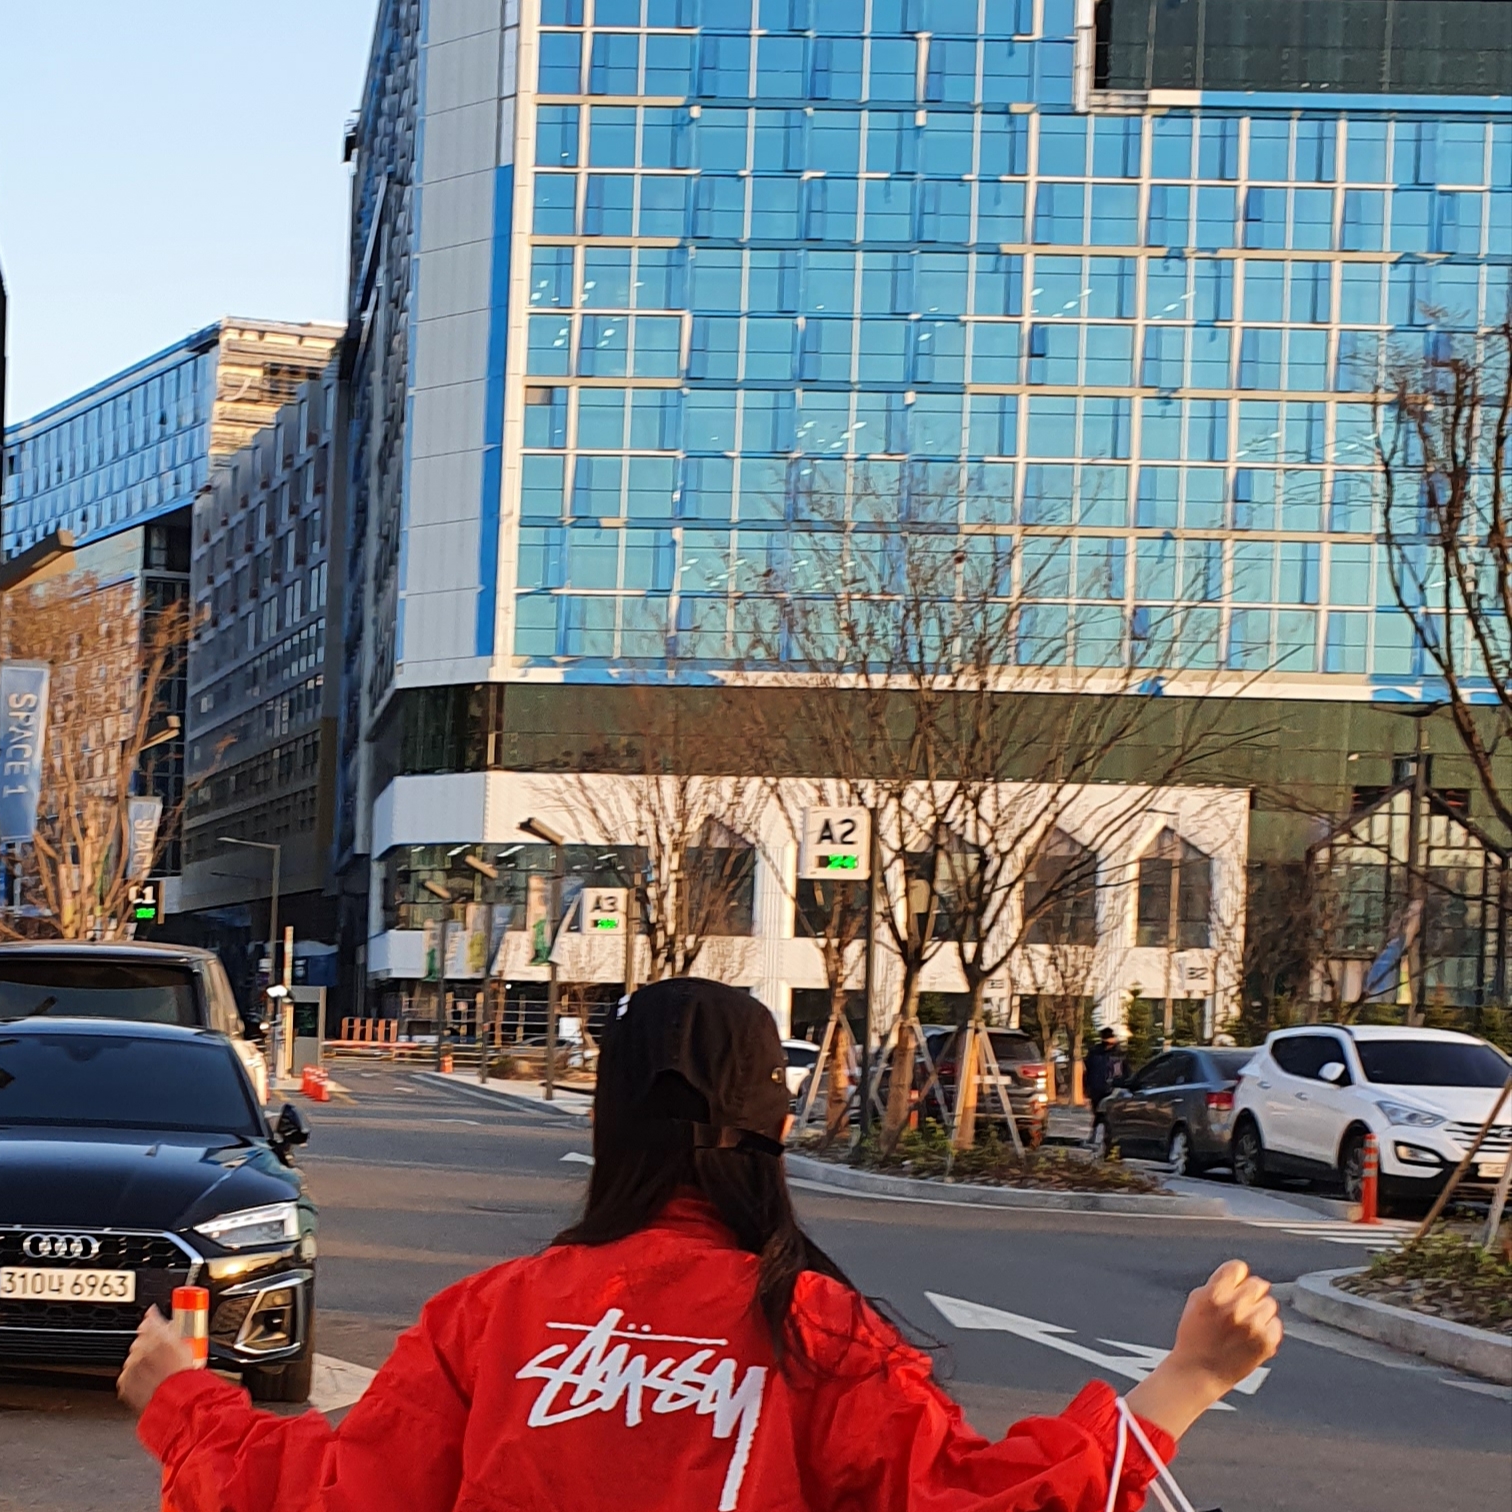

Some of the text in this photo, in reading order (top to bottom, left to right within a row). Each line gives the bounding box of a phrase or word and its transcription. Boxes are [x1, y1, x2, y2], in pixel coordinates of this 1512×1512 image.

[2, 692, 37, 799] SPACE 1
[816, 818, 860, 845] A2
[590, 895, 620, 913] A3
[70, 1274, 129, 1298] 6963
